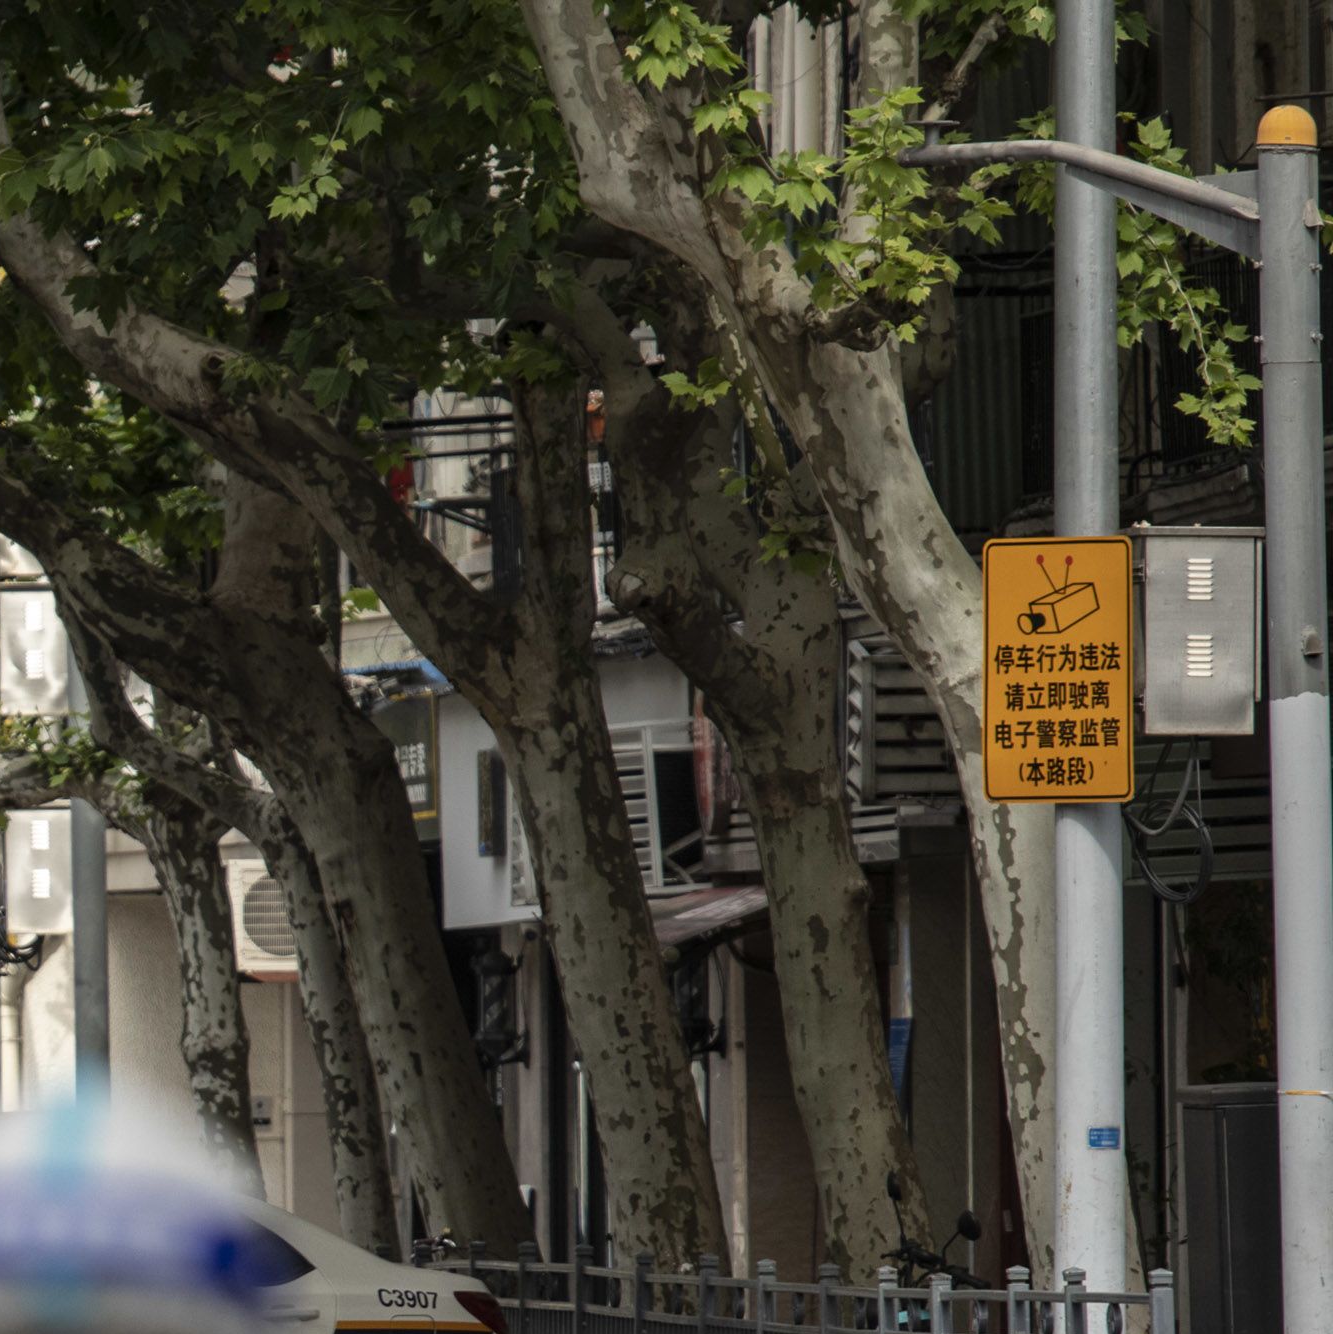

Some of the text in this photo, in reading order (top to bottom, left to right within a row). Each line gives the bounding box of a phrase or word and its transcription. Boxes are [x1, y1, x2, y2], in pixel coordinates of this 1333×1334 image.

[994, 642, 1121, 674] 停车行为违法
[1004, 680, 1110, 711] 请立即驶离
[995, 717, 1121, 749] 电子警察监管
[1019, 757, 1094, 786] (本路段)
[377, 1288, 438, 1309] C3907
